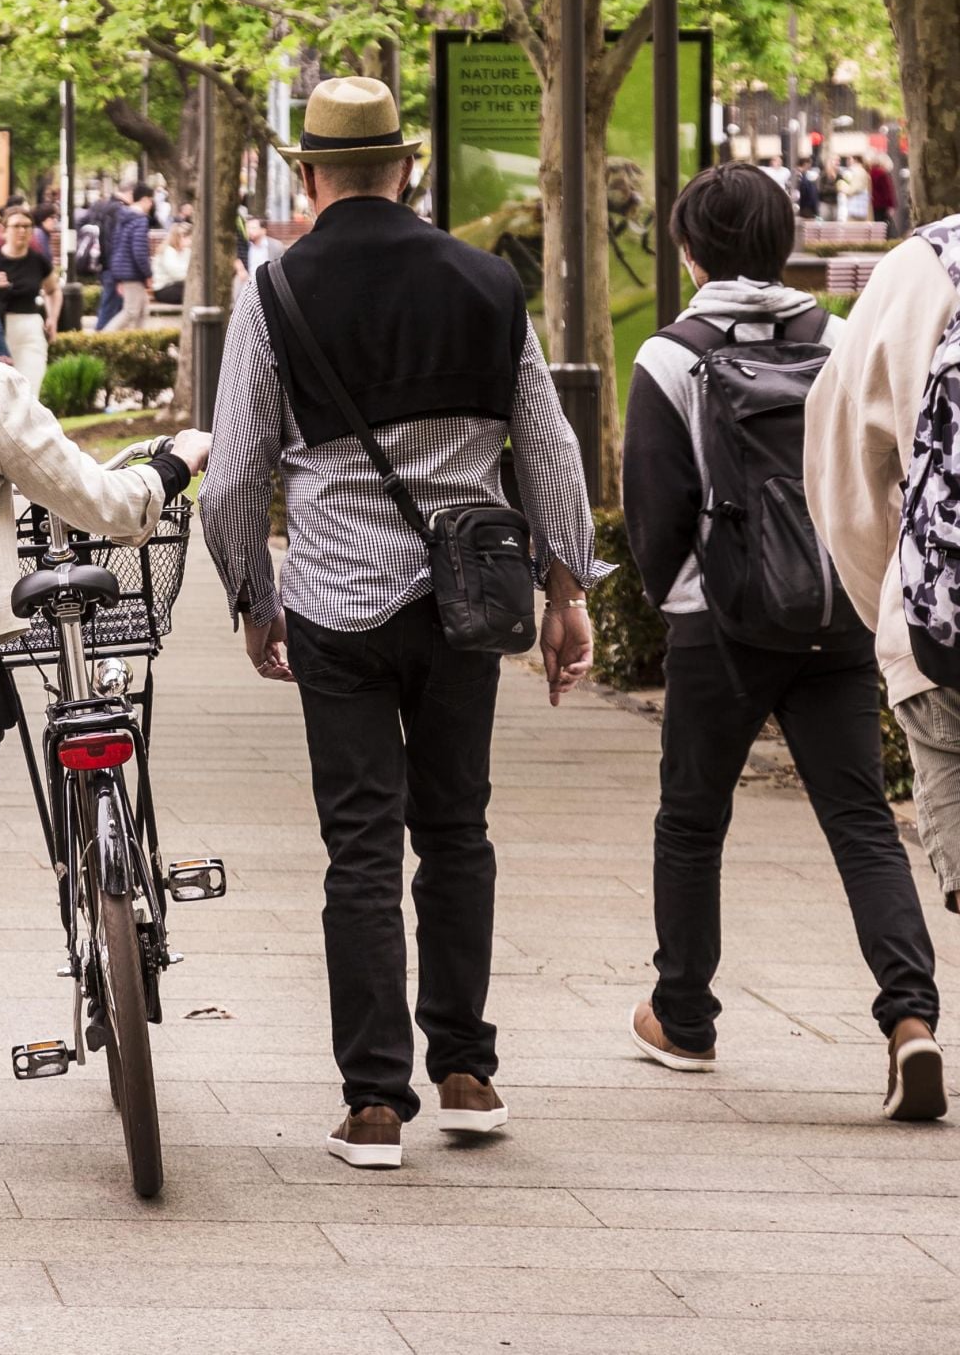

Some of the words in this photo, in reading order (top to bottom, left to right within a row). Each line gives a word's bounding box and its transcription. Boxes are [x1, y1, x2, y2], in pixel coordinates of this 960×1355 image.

[461, 68, 520, 79] NATURE
[461, 85, 542, 95] PHOTOGRA
[461, 101, 481, 112] OF
[487, 101, 514, 112] THE
[520, 101, 538, 112] YE
